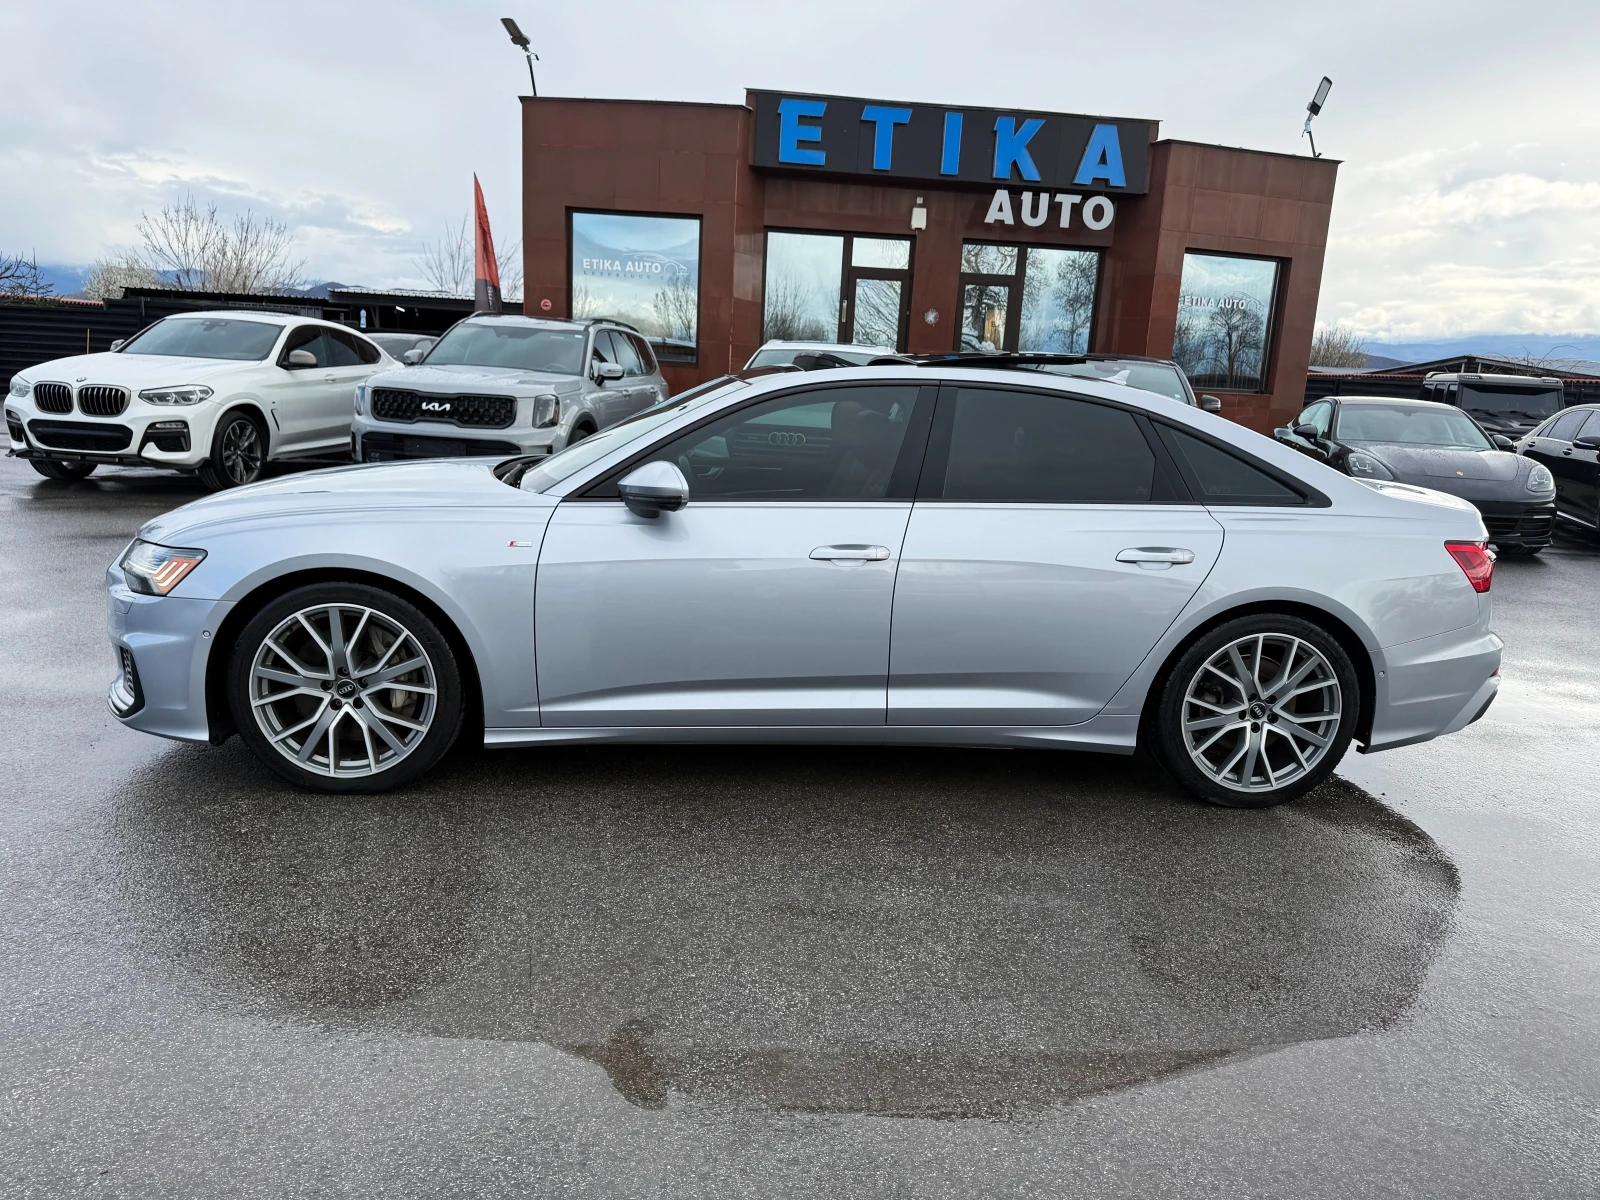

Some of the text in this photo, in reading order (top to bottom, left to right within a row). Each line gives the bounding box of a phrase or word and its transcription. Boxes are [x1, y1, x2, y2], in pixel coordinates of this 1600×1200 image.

[777, 98, 1127, 188] ETIKA
[984, 189, 1115, 231] AUTO
[583, 258, 661, 273] ETIKA AUTO
[1184, 296, 1246, 309] ETIKA AUTO
